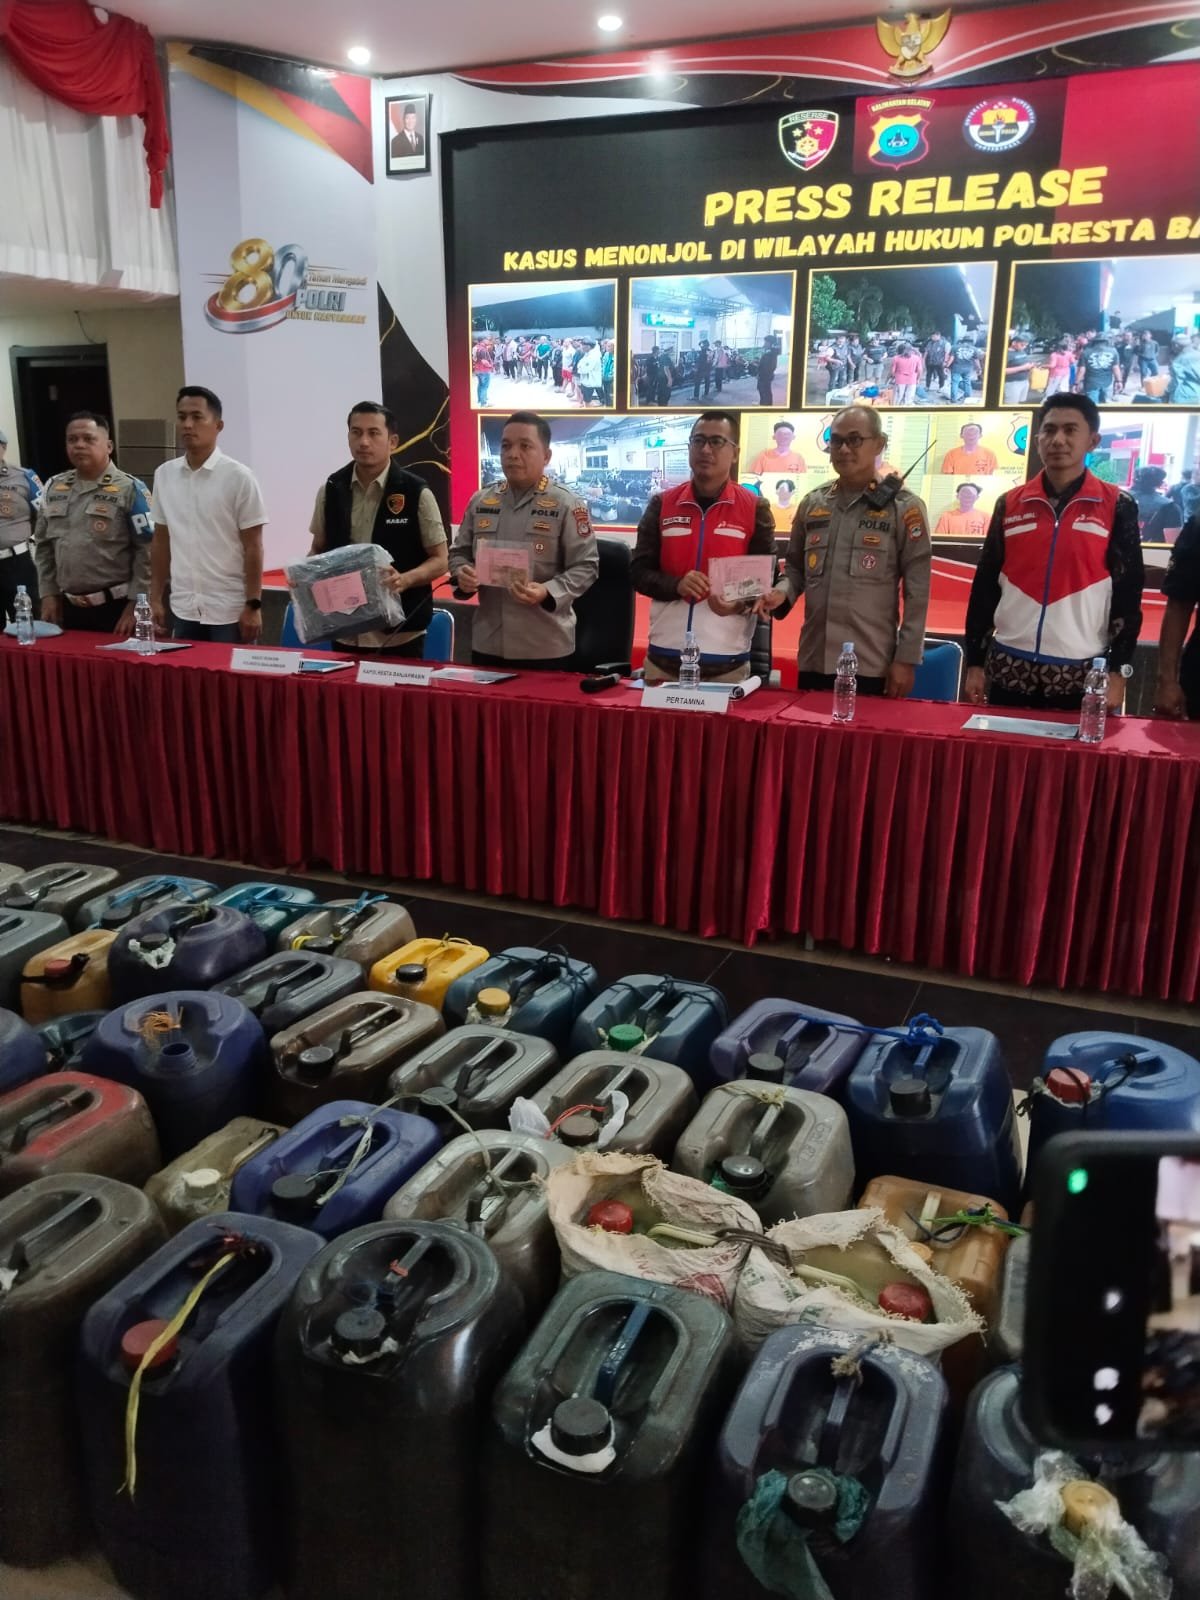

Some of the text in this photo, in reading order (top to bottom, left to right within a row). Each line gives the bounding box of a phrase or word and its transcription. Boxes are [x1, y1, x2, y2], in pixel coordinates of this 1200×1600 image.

[789, 112, 829, 123] RESERSE
[704, 166, 1108, 227] PRESS RELEASE
[503, 249, 578, 271] KASUS
[584, 241, 713, 267] MENONJOL
[720, 239, 746, 261] DI
[753, 231, 876, 259] WILAYAH
[884, 226, 985, 252] HUKUM
[993, 218, 1156, 247] POLRESTA
[217, 238, 308, 312] 80
[296, 289, 346, 311] POLRI
[531, 509, 559, 518] POLRI
[858, 520, 890, 532] POLRI
[665, 696, 705, 705] PERTAMINA
